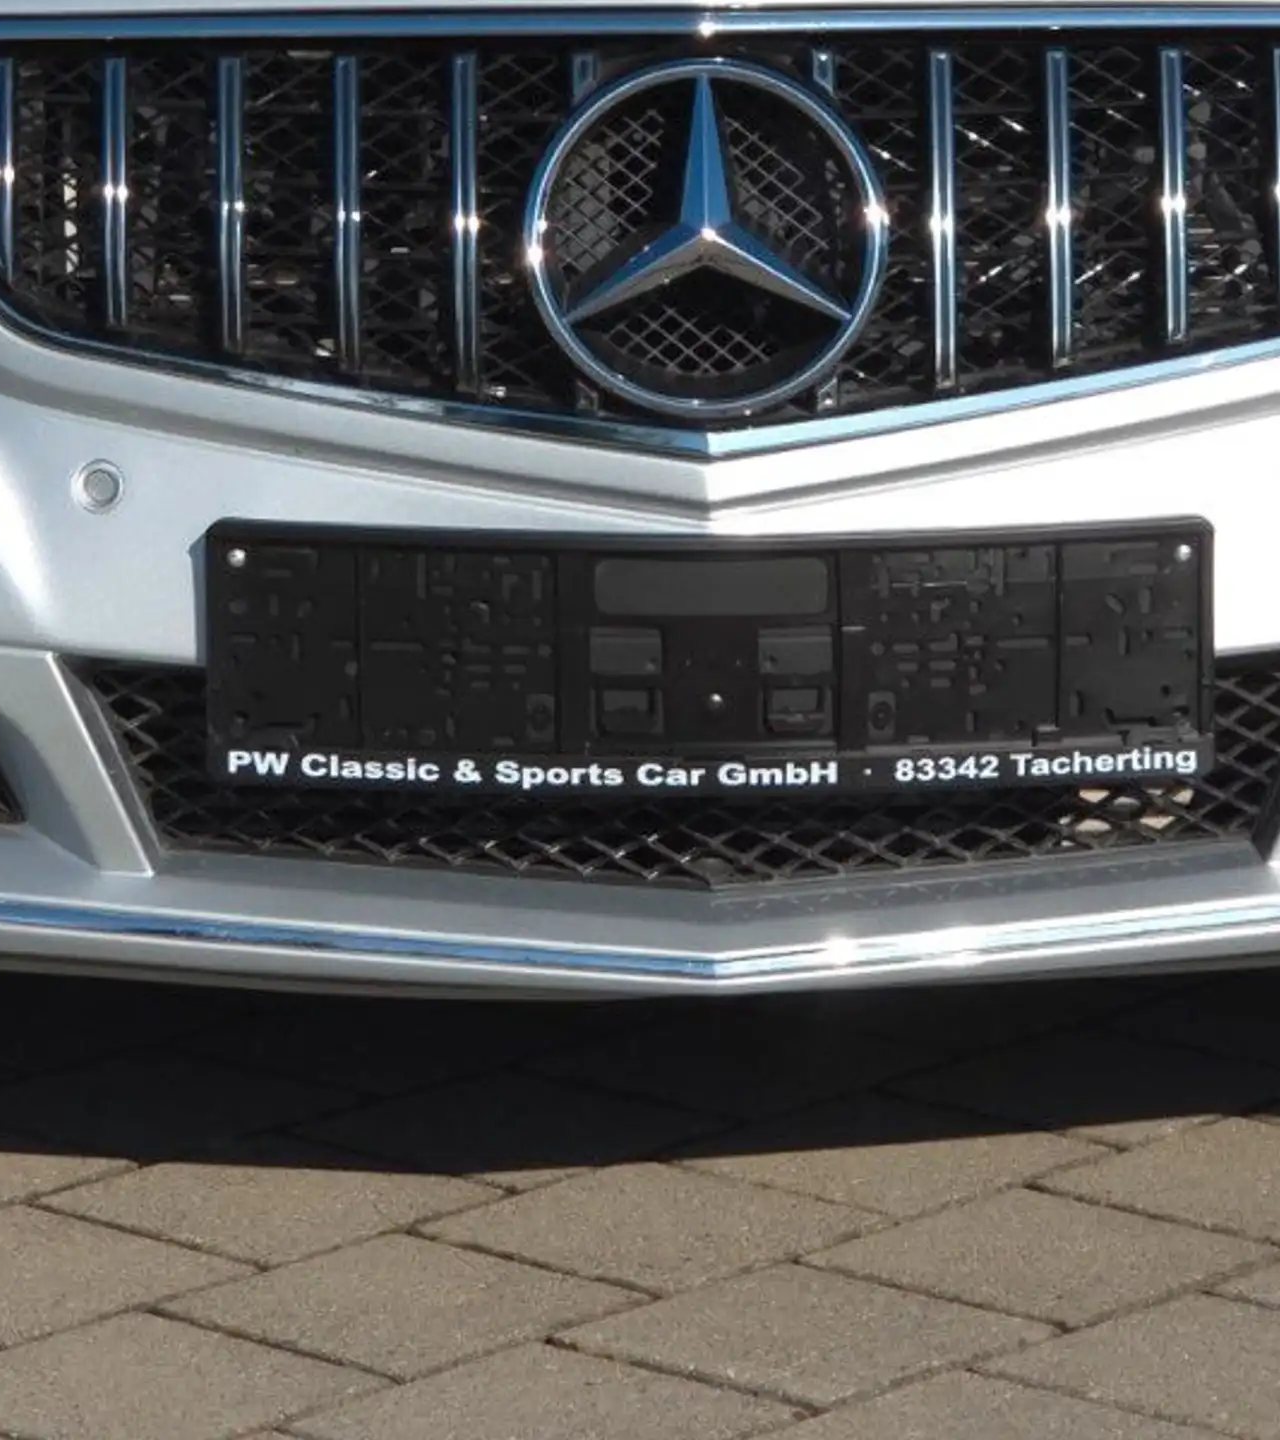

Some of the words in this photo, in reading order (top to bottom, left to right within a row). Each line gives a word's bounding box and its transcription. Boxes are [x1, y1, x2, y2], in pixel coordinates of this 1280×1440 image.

[227, 750, 290, 776] PW
[300, 753, 441, 782] Classic
[452, 758, 483, 784] &
[494, 760, 625, 790] Sports
[636, 762, 706, 788] Car
[716, 760, 838, 788] GmbH
[893, 754, 1000, 782] 83342
[1009, 745, 1198, 777] Tacherting
